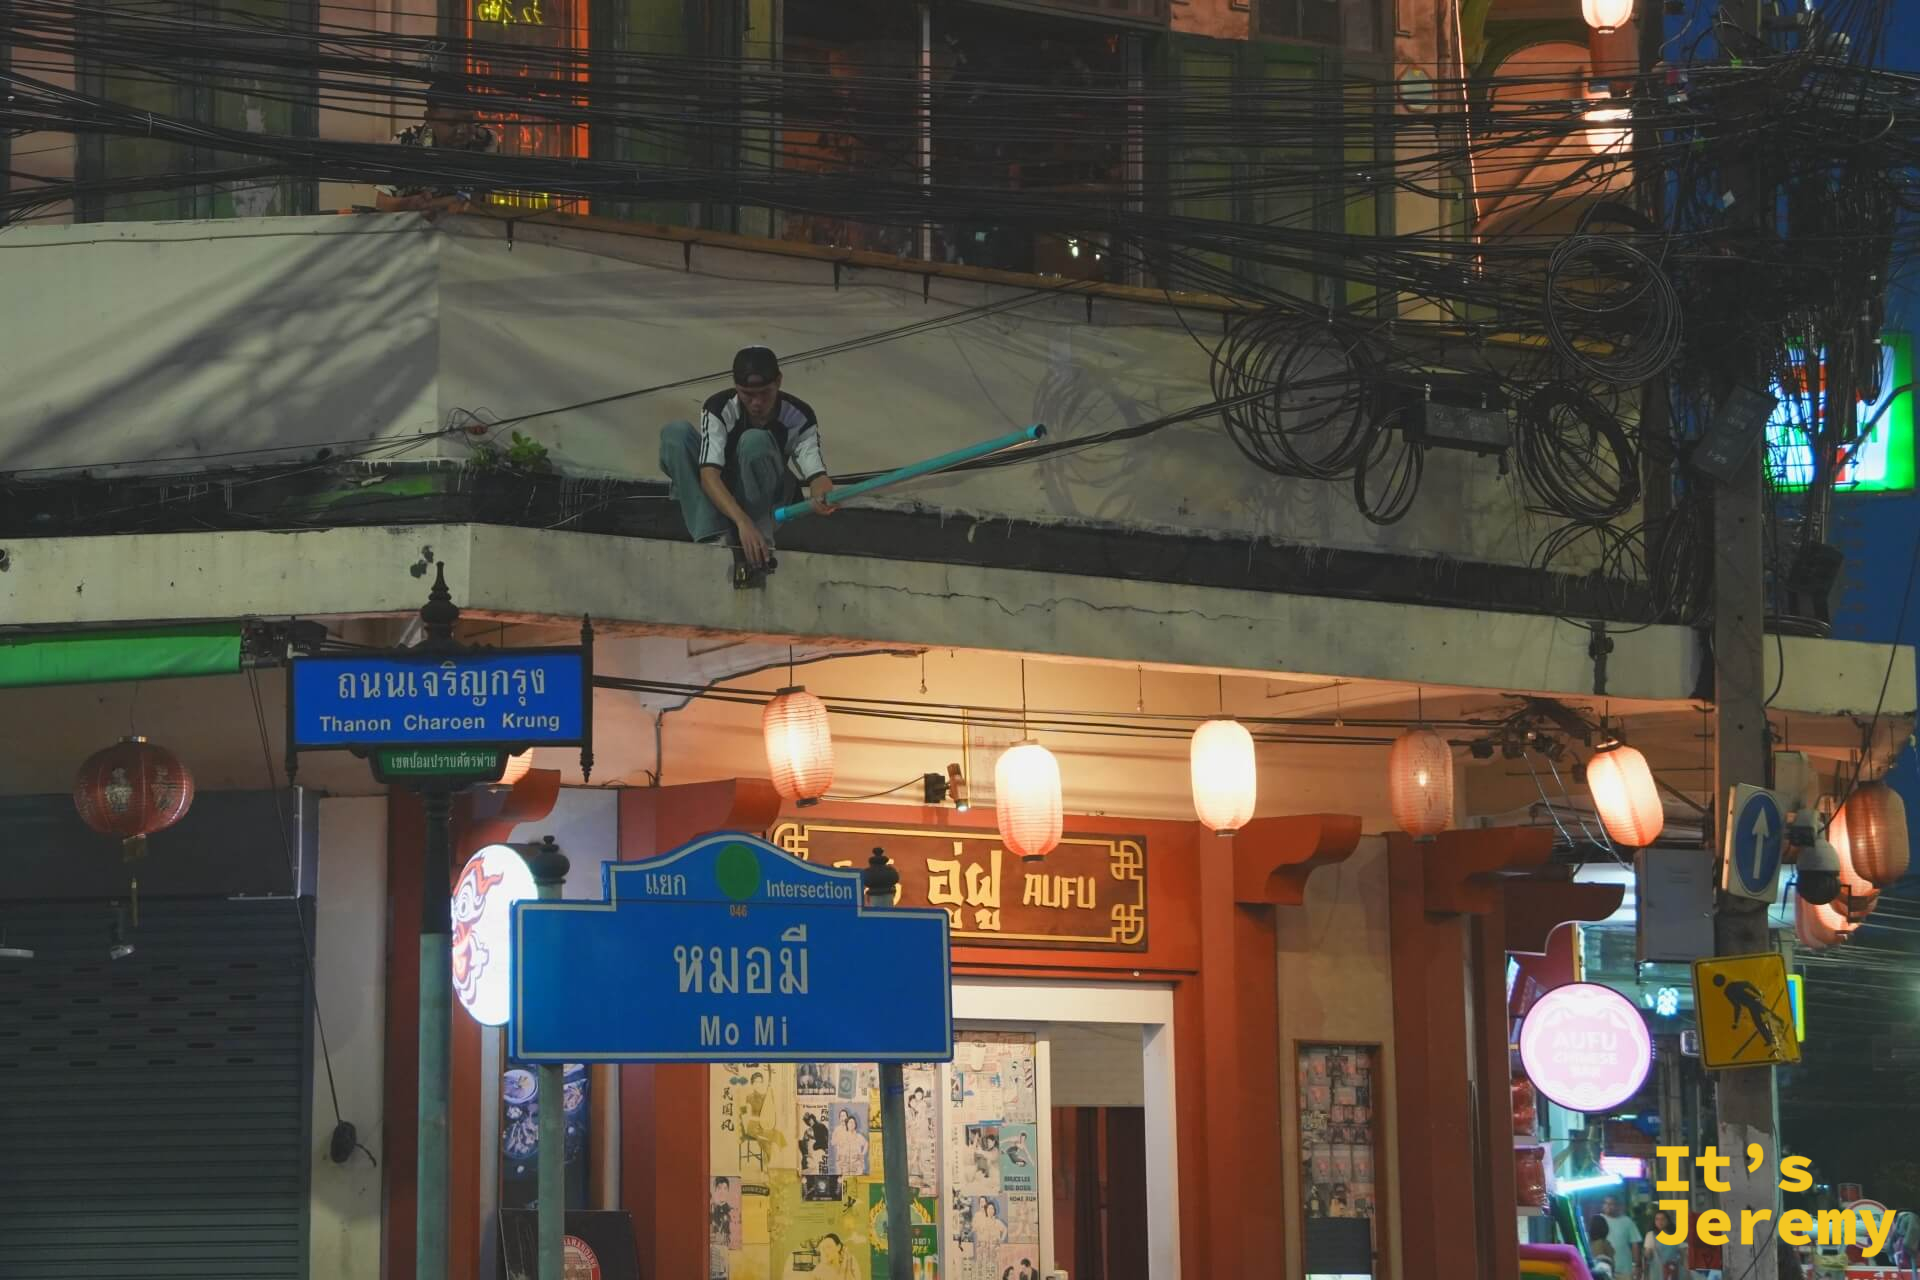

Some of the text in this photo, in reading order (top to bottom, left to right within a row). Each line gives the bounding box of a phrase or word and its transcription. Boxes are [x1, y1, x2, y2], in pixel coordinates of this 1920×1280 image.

[338, 660, 545, 707] ถนนเจริญกรุง
[319, 712, 560, 732] Thanon Charoen Krung
[645, 872, 687, 896] แยก
[766, 879, 852, 900] Intersection
[1022, 873, 1096, 910] AUFU
[673, 923, 809, 994] หมอมี
[700, 1015, 788, 1046] Mo Mi
[1551, 1031, 1617, 1051] AUFU
